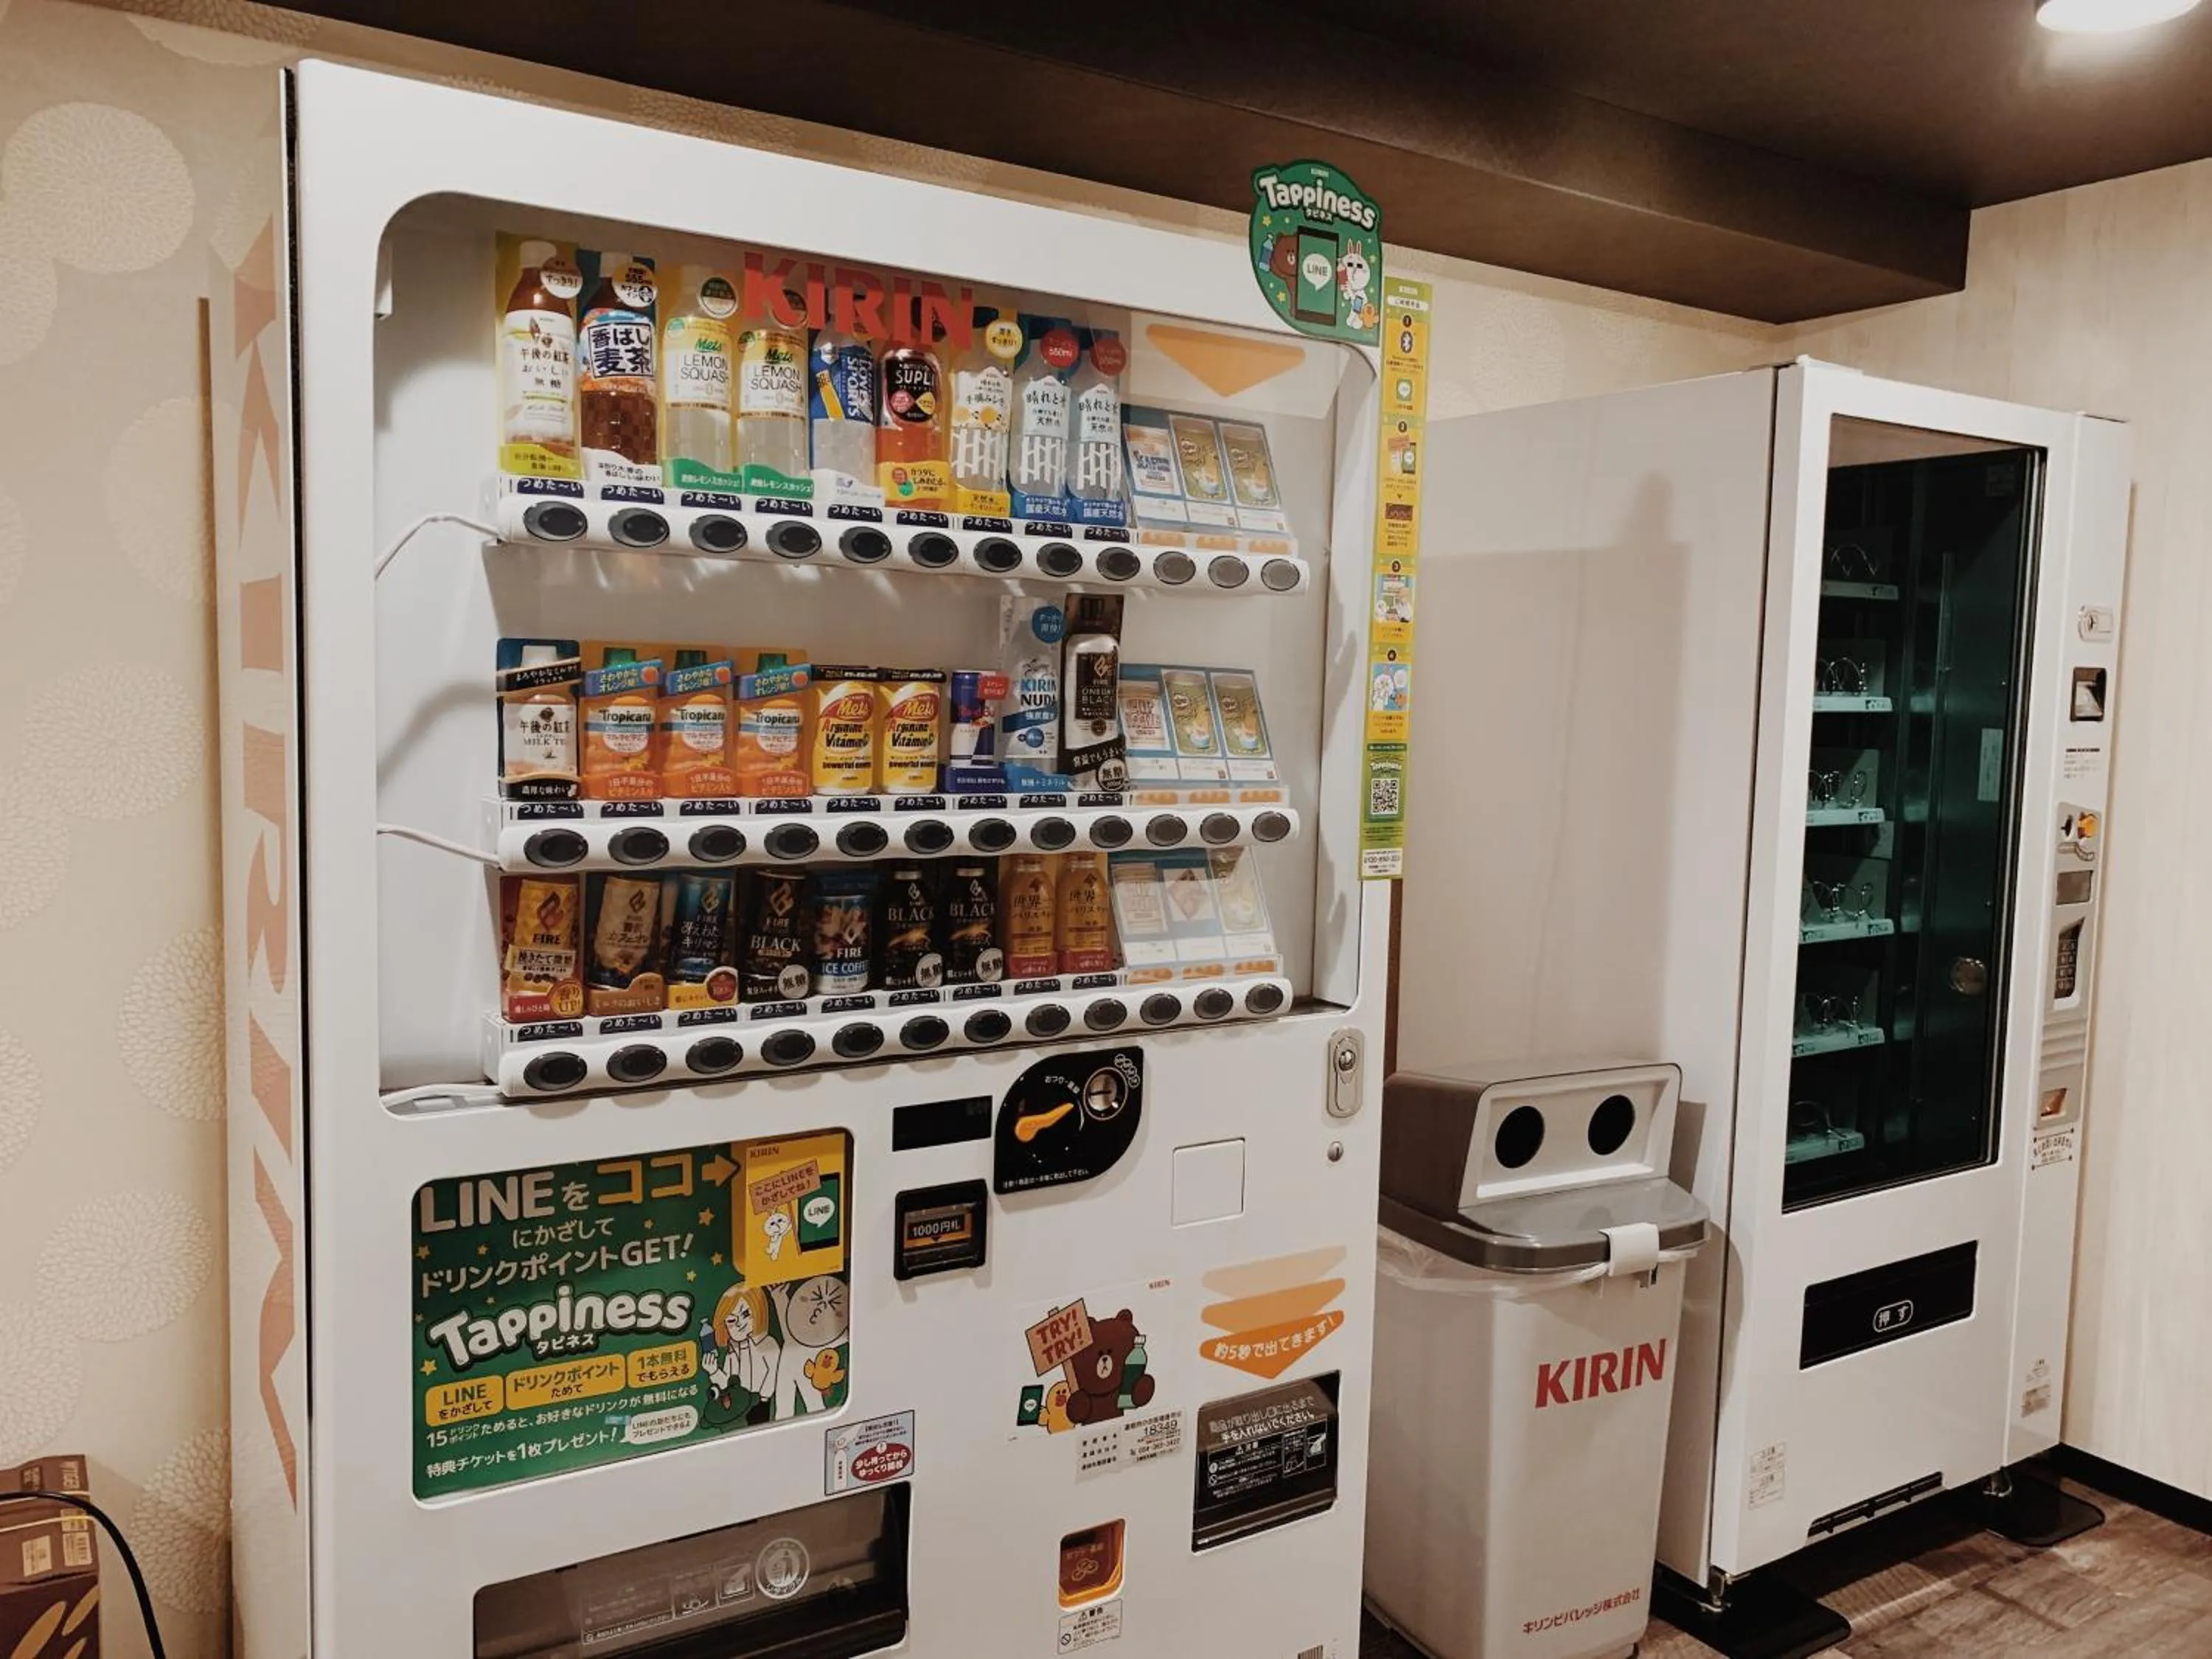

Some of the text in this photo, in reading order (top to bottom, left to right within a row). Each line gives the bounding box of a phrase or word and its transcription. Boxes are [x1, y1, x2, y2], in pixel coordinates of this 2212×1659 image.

[1259, 175, 1376, 229] Tappiness
[1307, 264, 1329, 276] LINE
[744, 251, 973, 352] KIRIN
[592, 327, 650, 348] 香ばし
[593, 347, 651, 375] 麦茶
[684, 353, 728, 371] LEMON
[754, 365, 801, 381] LEMON
[837, 698, 870, 717] Mets
[902, 698, 935, 717] Mets
[234, 215, 297, 1512] KIRIN
[532, 933, 561, 945] FIRE
[751, 935, 801, 953] BLACK
[837, 946, 862, 959] FIRE
[754, 1167, 815, 1197] ここにLINEを
[762, 1179, 811, 1206] かざしてね!
[807, 1204, 830, 1217] LINE
[512, 1217, 615, 1250] にかざして
[912, 1218, 961, 1238] 1000円札
[420, 1233, 694, 1298] ドリンクポイントGET!
[430, 1284, 692, 1367] Tappiness
[1878, 1304, 1909, 1327] 押す
[1036, 1309, 1079, 1344] TRY!
[537, 1334, 595, 1354] タピネス
[1042, 1327, 1085, 1365] TRY!
[1214, 1315, 1335, 1360] 約5秒で出てきます!
[637, 1351, 687, 1369] 1本無料
[513, 1361, 621, 1392] ドリンクポイント
[636, 1366, 690, 1382] でもらえる
[1534, 1338, 1666, 1409] KIRIN
[442, 1383, 487, 1405] LINE
[551, 1384, 585, 1400] ためて
[438, 1400, 493, 1420] をかざして
[1144, 1419, 1178, 1436] 18349
[426, 1430, 448, 1449] 15
[1523, 1587, 1641, 1635] キリンビバレッジ株式会社
